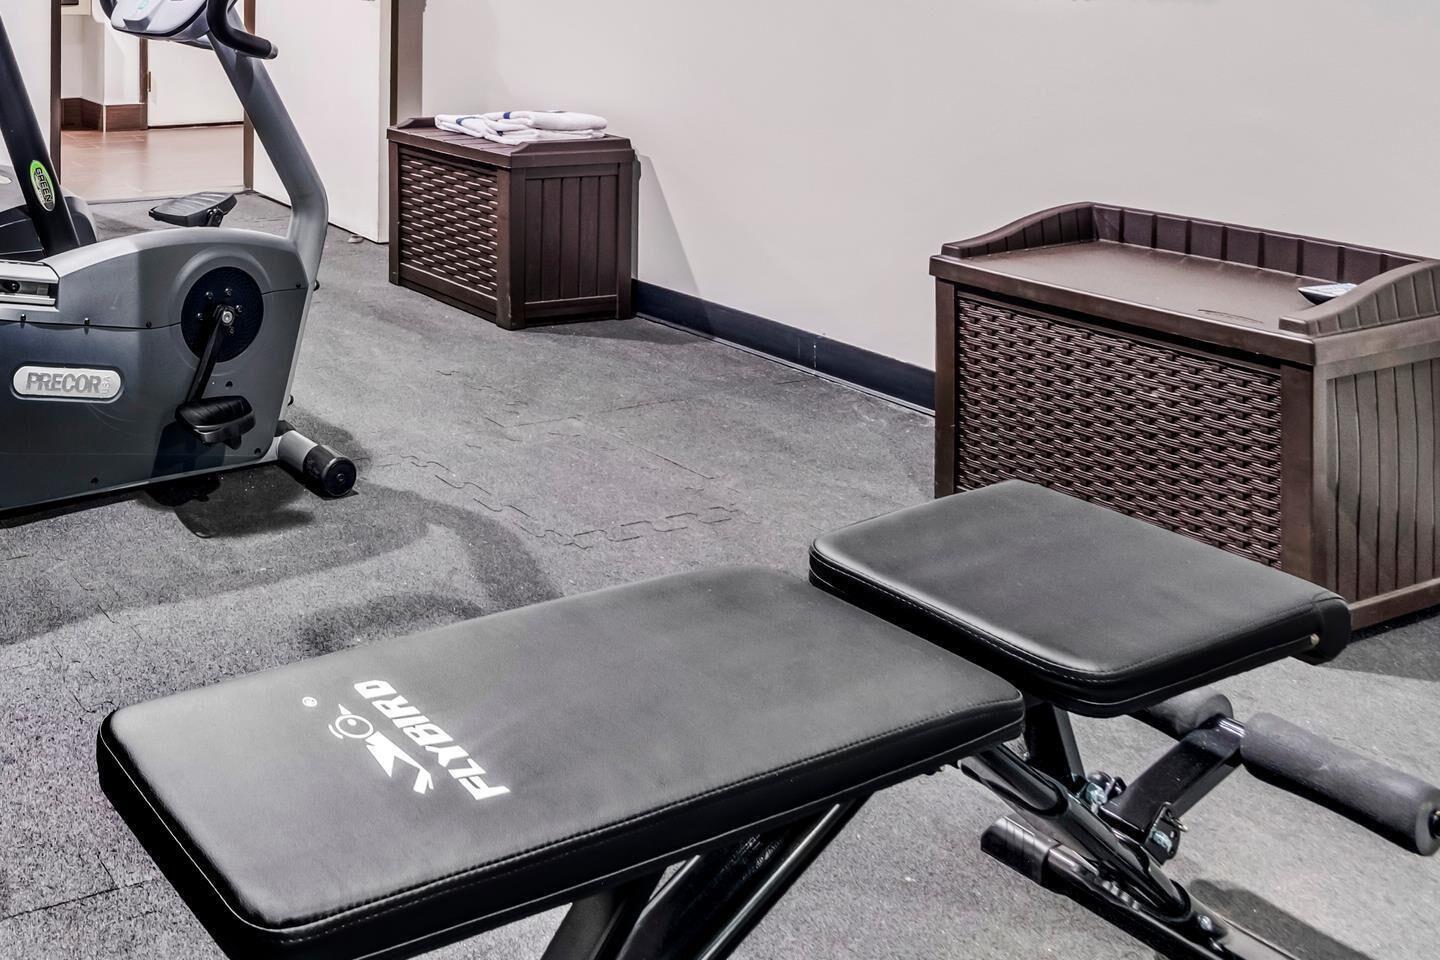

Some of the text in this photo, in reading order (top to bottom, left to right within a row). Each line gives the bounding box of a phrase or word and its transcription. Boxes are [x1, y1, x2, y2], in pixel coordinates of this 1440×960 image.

[35, 167, 53, 202] GREEN
[26, 372, 101, 394] PRECOR
[354, 679, 511, 800] FLYBIRD
